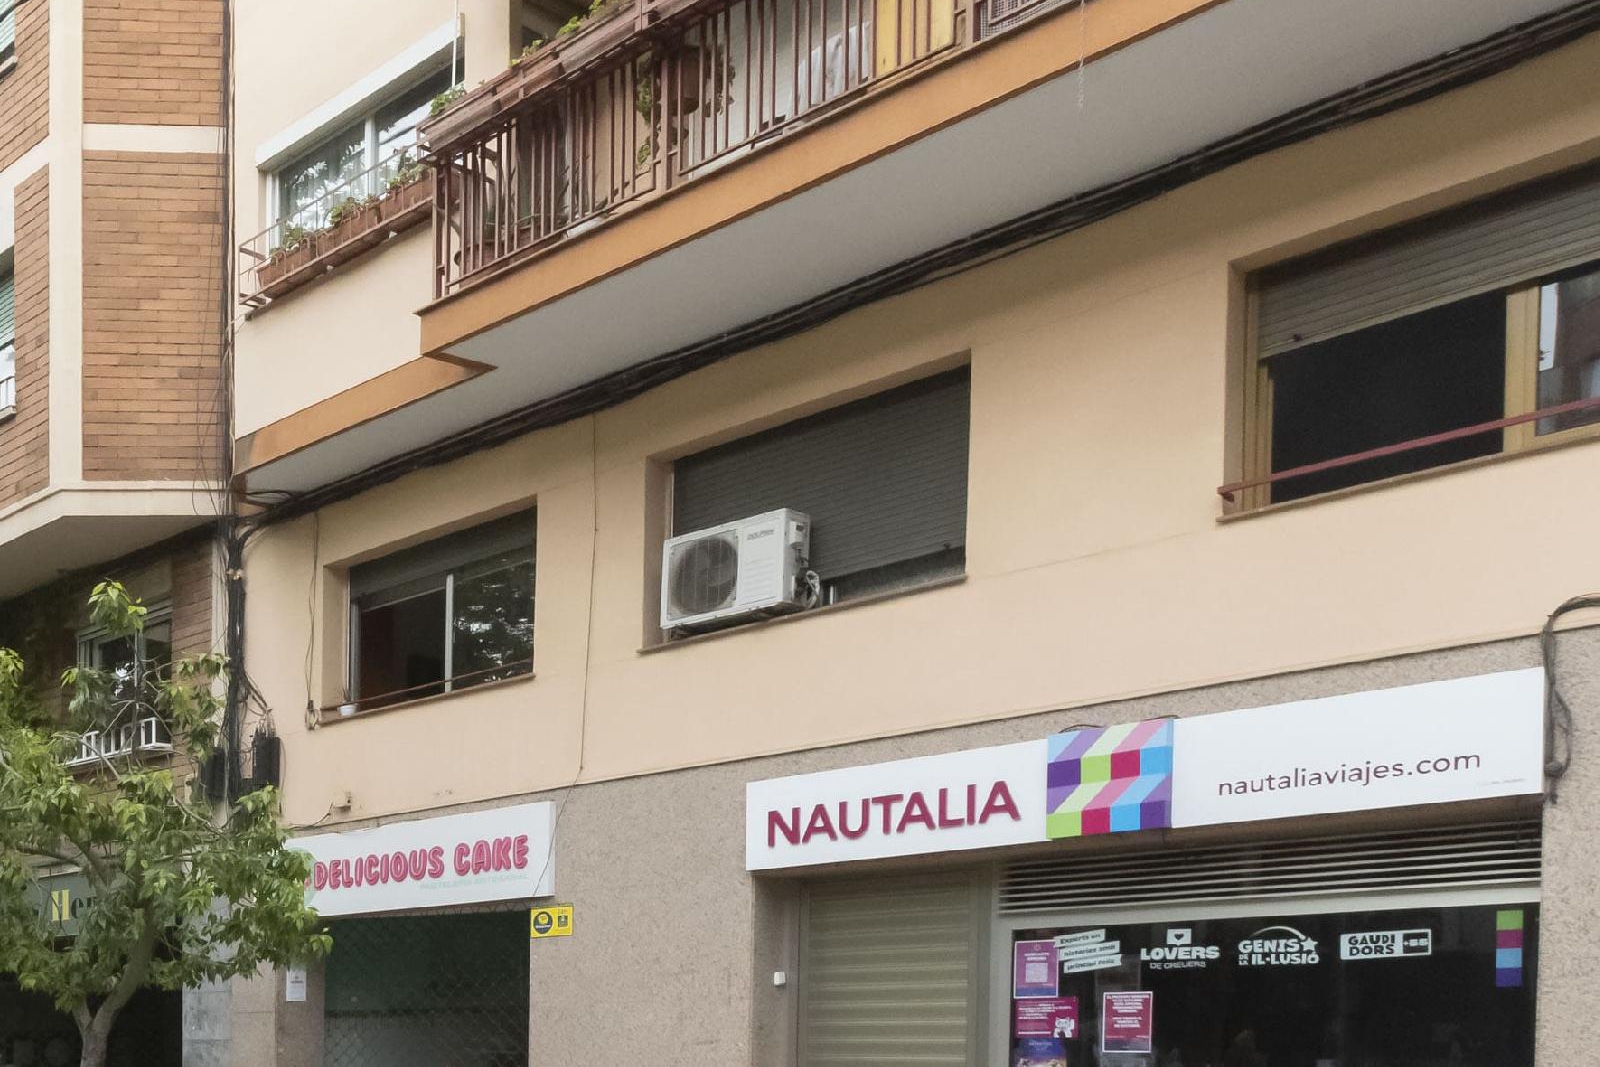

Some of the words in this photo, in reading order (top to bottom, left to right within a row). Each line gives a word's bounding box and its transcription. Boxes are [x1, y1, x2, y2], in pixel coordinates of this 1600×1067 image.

[1217, 754, 1481, 795] nautaliaviajes.com
[767, 781, 1022, 847] NAUTALIA
[313, 846, 445, 891] DELICIOUS
[453, 834, 529, 876] CAKE
[1238, 939, 1300, 953] GENIS
[1348, 934, 1396, 946] GAUDI
[1140, 946, 1220, 960] LOVERS
[1349, 944, 1395, 956] DORS
